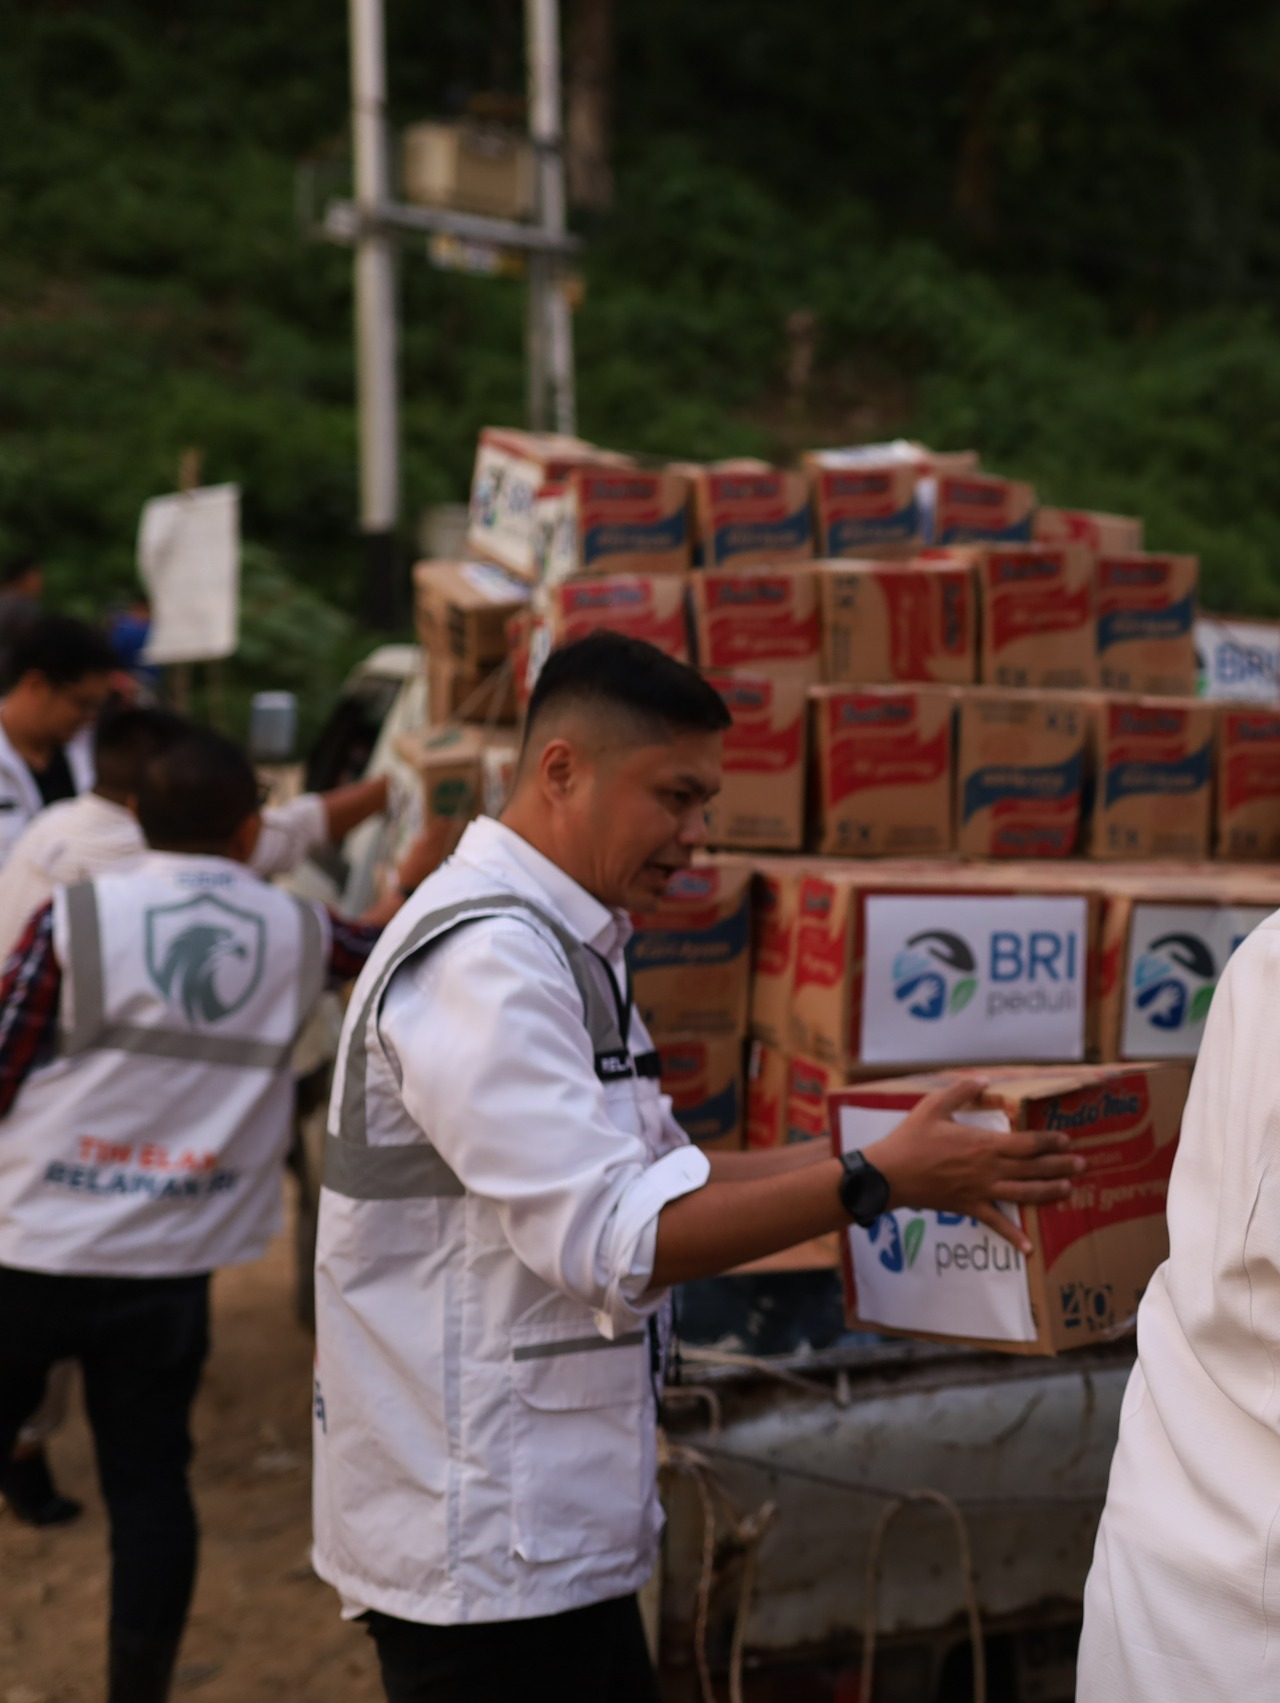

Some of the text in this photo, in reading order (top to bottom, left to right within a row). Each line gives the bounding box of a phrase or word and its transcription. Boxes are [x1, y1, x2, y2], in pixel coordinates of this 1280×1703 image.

[989, 931, 1076, 982] BRI
[986, 987, 1076, 1019] peduli
[600, 1055, 632, 1073] REL
[936, 1235, 1022, 1276] pedul
